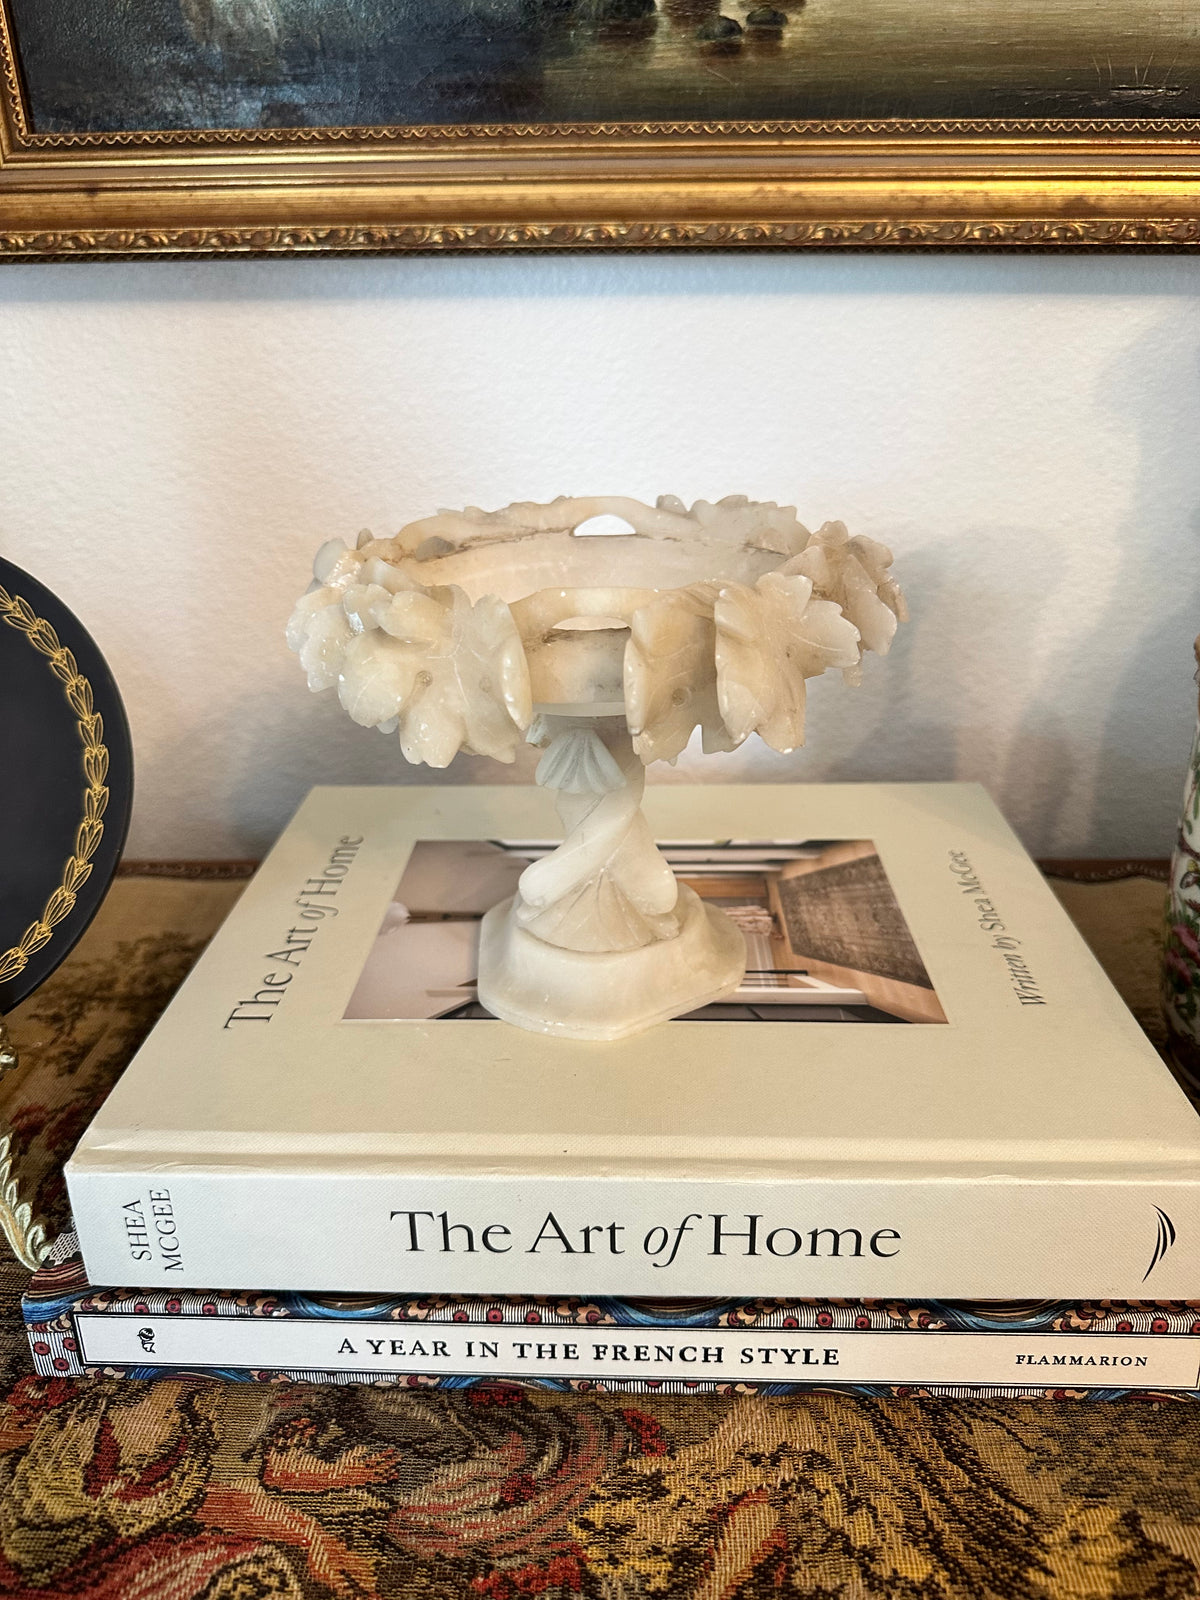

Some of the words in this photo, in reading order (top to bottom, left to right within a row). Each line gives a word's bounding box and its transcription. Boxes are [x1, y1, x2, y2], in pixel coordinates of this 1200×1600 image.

[300, 835, 364, 896] Home
[948, 850, 985, 894] McGee
[295, 898, 339, 921] of
[974, 898, 1005, 931] Shea
[264, 926, 319, 966] Art
[991, 934, 1022, 950] by
[223, 972, 294, 1030] The
[1003, 953, 1047, 1005] Written
[122, 1199, 152, 1262] SHEA
[150, 1188, 184, 1272] MCGEE
[390, 1210, 513, 1254] The
[525, 1211, 625, 1254] Art
[642, 1213, 702, 1267] of
[707, 1213, 902, 1258] Home
[337, 1337, 358, 1355] A
[366, 1339, 451, 1357] YEAR
[465, 1341, 499, 1358] IN
[512, 1342, 581, 1360] THE
[592, 1344, 725, 1364] FRENCH
[740, 1347, 841, 1367] STYLE
[1015, 1354, 1149, 1367] FLAMMARION
